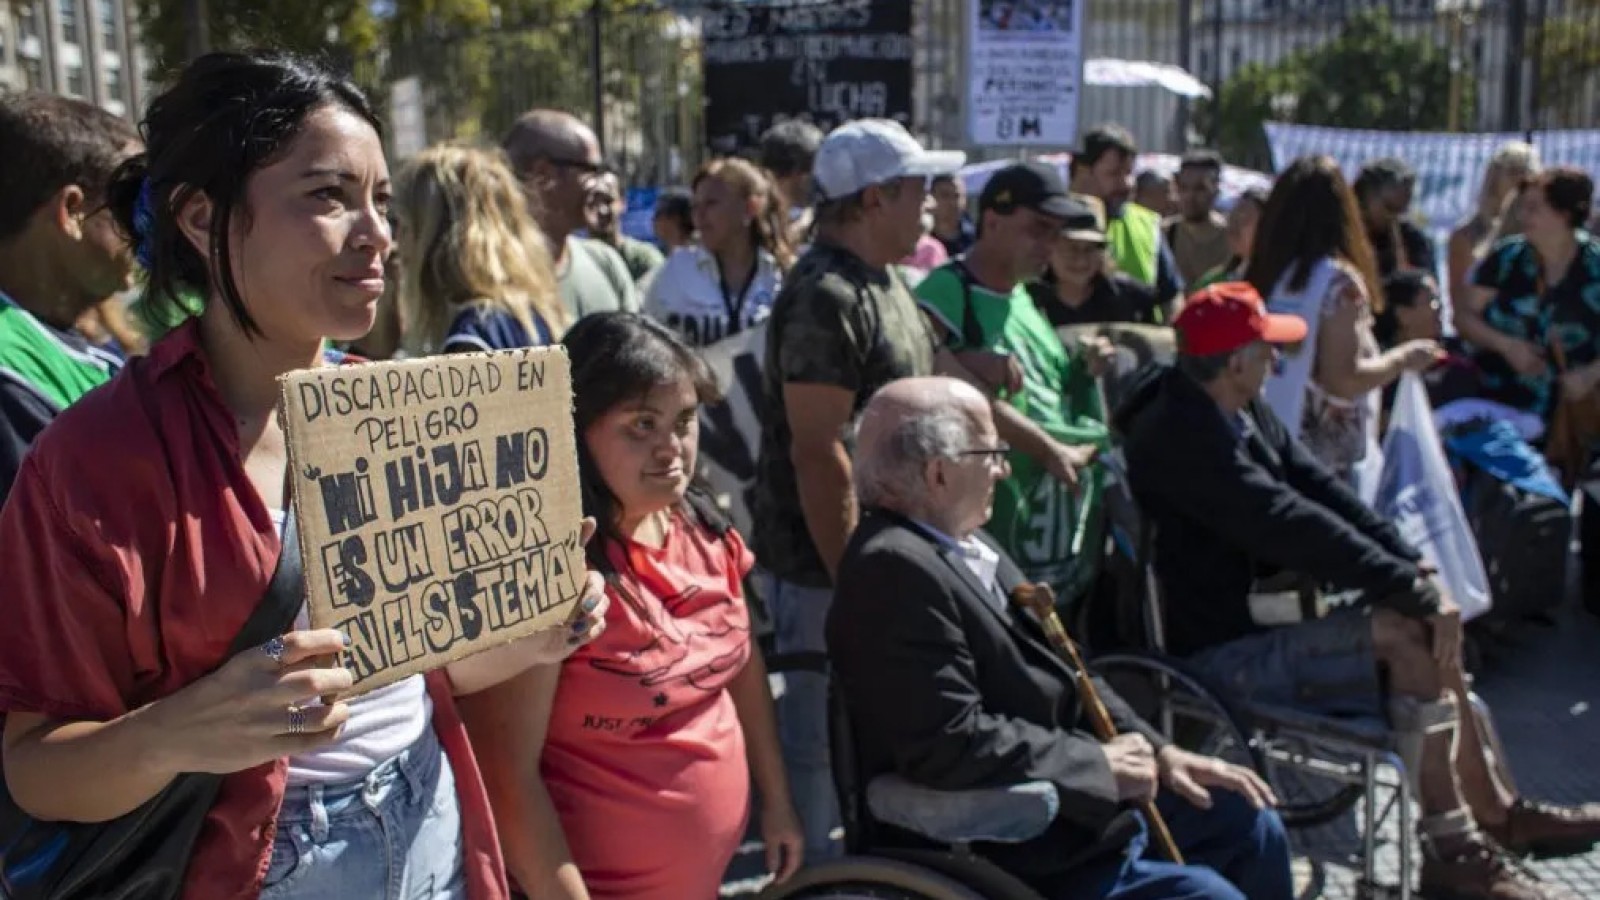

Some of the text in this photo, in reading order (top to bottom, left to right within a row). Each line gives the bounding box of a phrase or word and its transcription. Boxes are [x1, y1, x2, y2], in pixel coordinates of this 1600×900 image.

[808, 80, 887, 118] LUCHA
[496, 427, 549, 490] NO
[321, 487, 550, 609] ES UN ERROR
